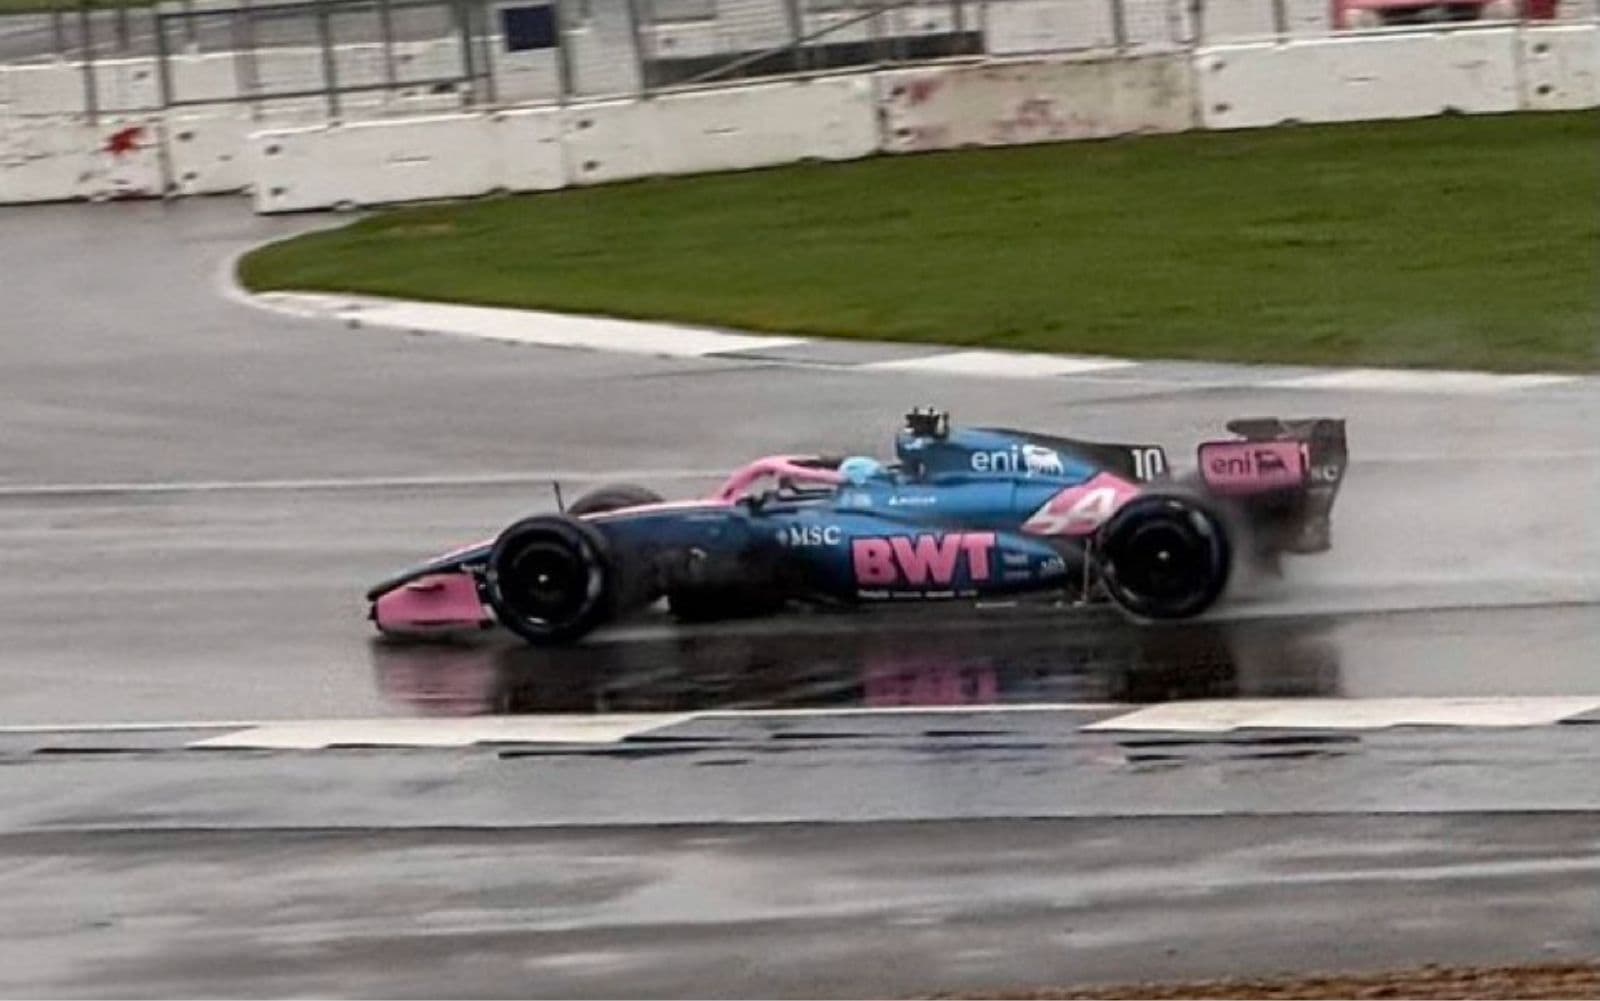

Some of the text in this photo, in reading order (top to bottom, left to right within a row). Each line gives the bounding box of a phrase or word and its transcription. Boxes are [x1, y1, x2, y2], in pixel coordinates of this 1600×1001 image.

[971, 444, 1018, 473] eni
[1132, 449, 1161, 481] 10
[1210, 450, 1250, 475] eni
[790, 525, 841, 546] MSC
[852, 532, 995, 585] BWT
